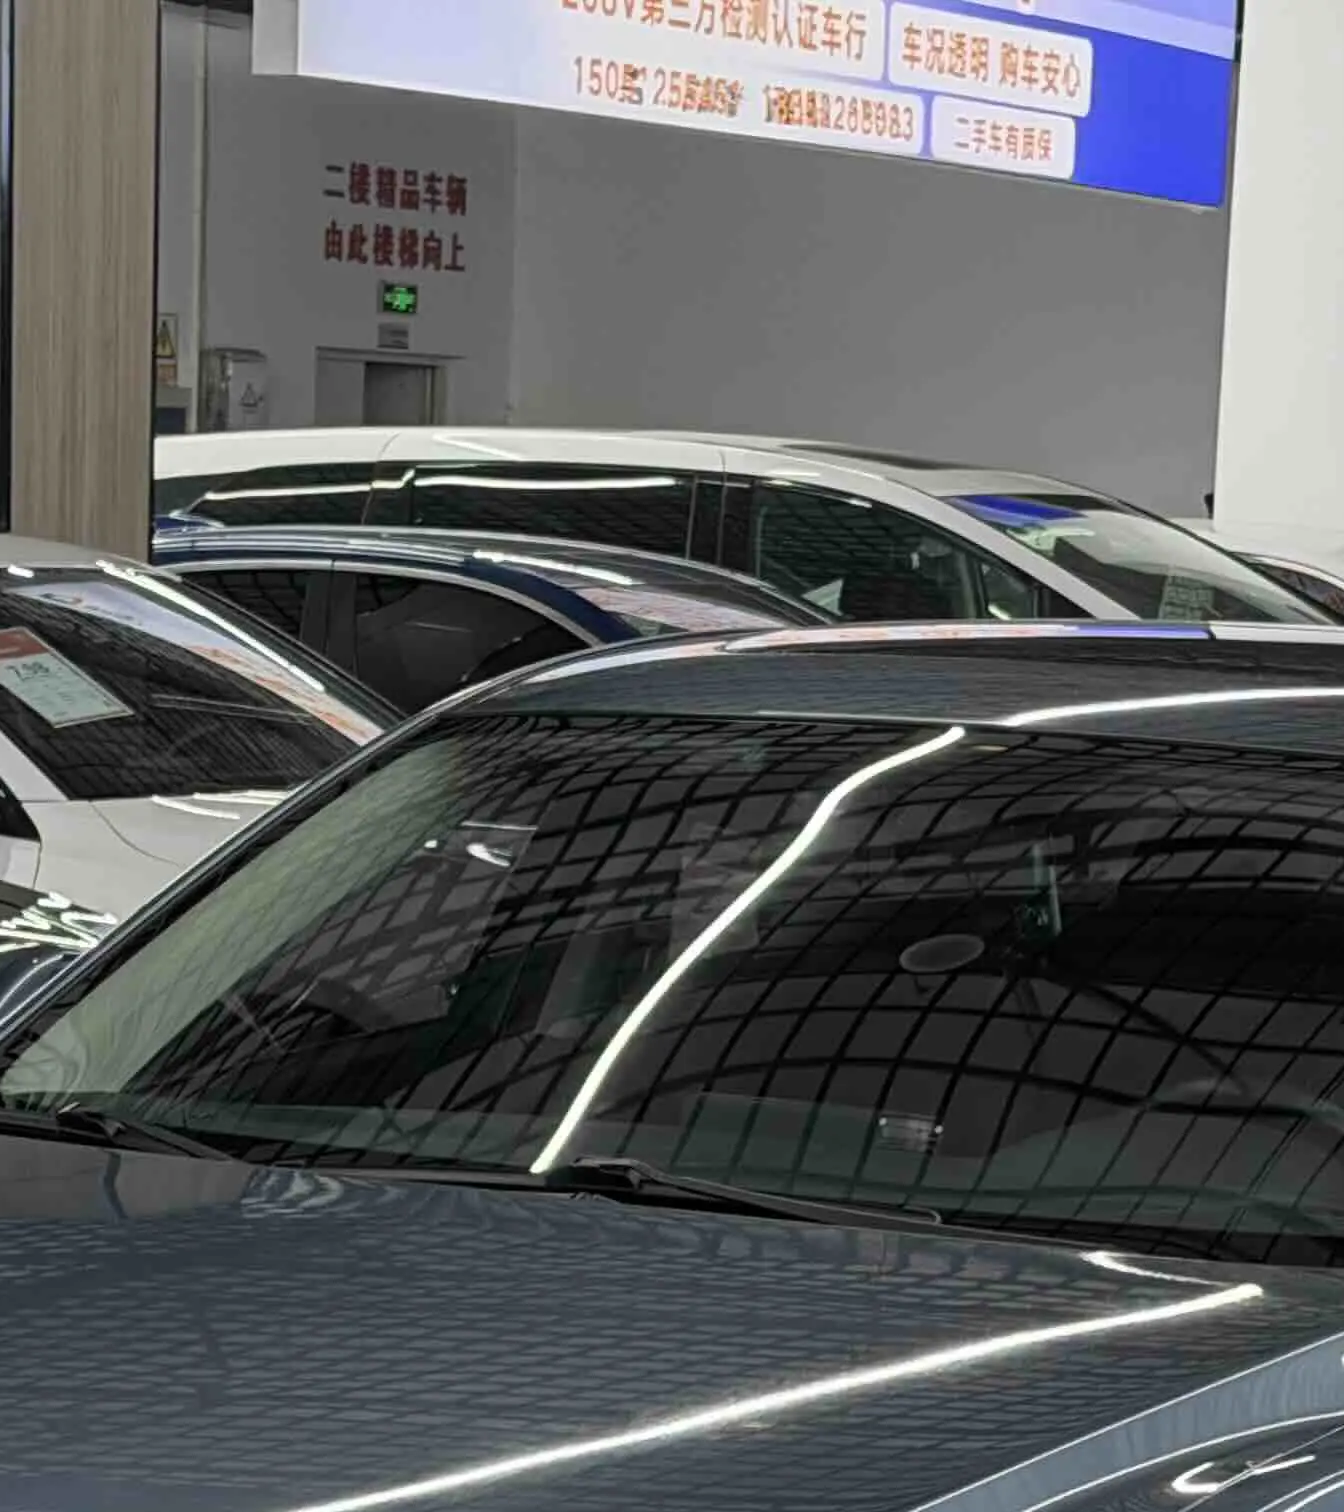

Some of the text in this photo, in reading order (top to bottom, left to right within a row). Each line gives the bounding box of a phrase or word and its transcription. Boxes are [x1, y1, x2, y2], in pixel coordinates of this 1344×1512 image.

[902, 22, 1081, 98] 车况透明 购车安心
[323, 162, 468, 216] 二楼精品车辆
[323, 218, 466, 272] 由此楼梯向上
